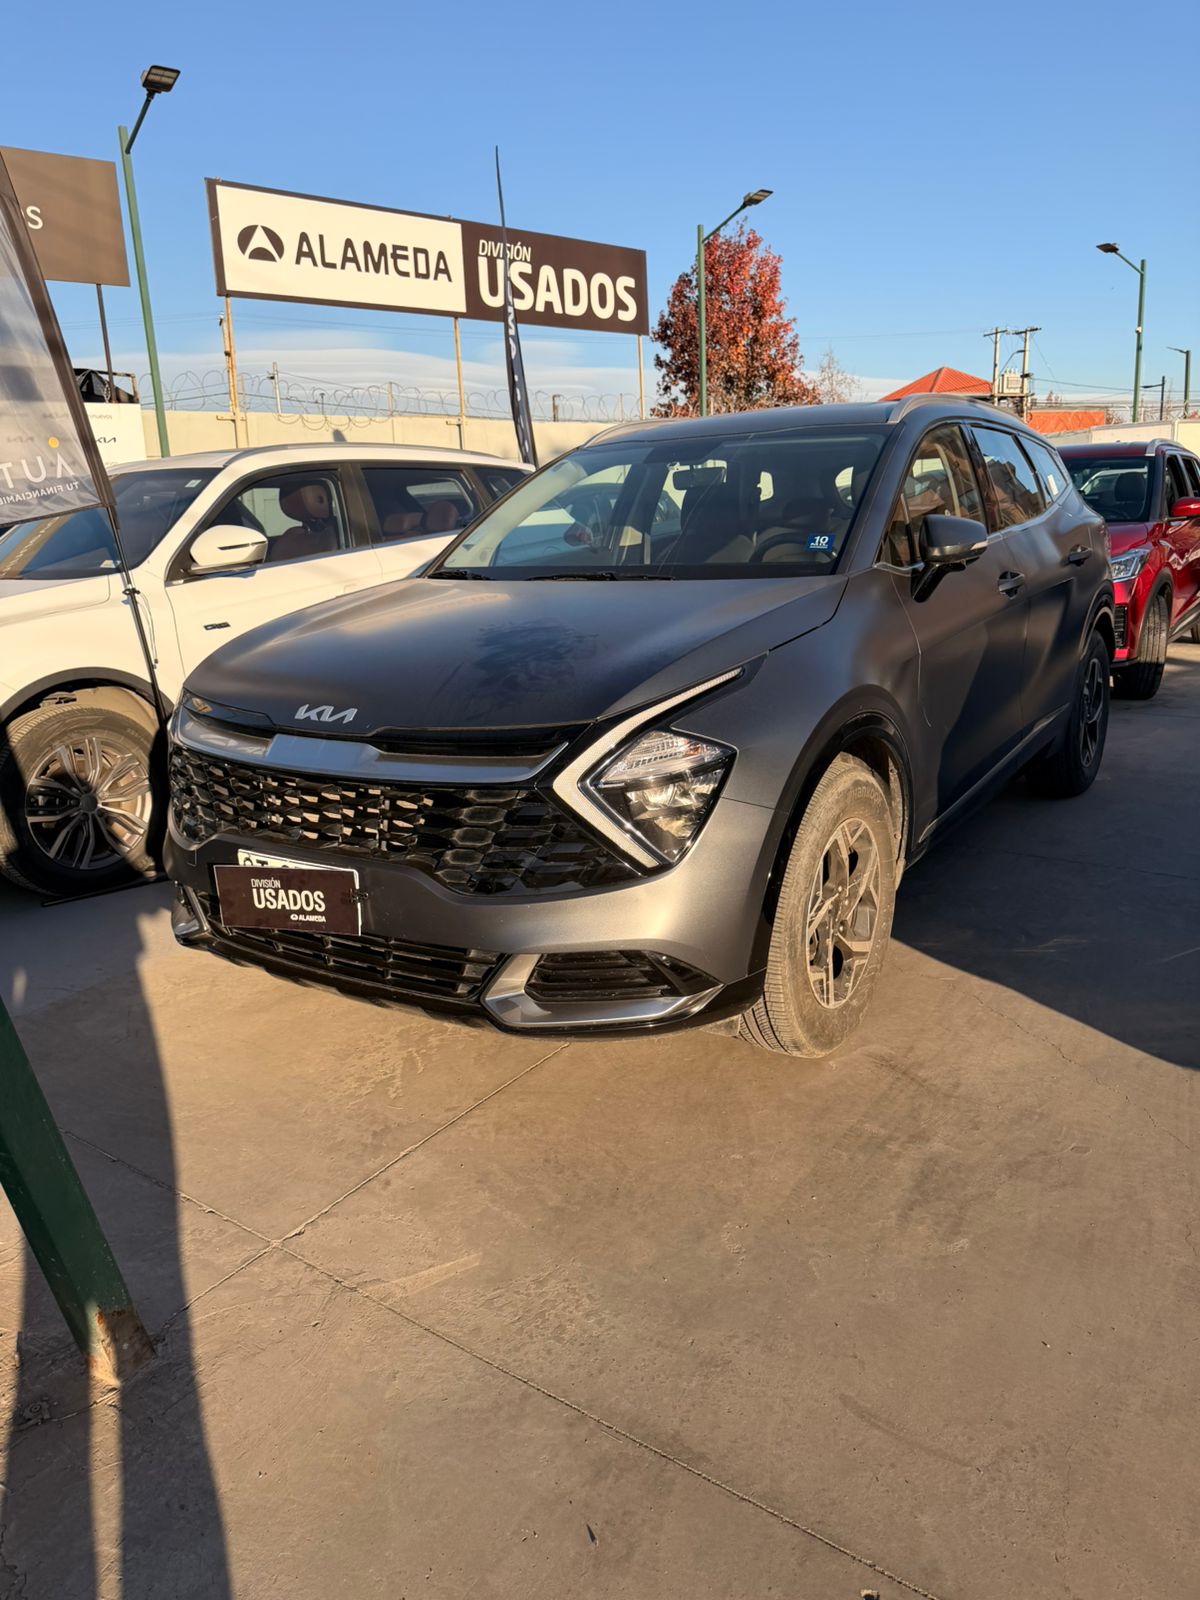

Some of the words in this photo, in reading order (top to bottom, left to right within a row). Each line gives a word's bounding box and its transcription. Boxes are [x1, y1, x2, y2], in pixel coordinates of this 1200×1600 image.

[295, 231, 452, 282] ALAMEDA
[479, 239, 531, 261] DIVISIÓN
[478, 256, 637, 322] USADOS
[814, 536, 829, 546] 10
[295, 704, 357, 724] KIA
[251, 877, 281, 889] DIVISIÓN
[252, 888, 326, 912] USADOS
[299, 914, 326, 922] ALAMEDA
